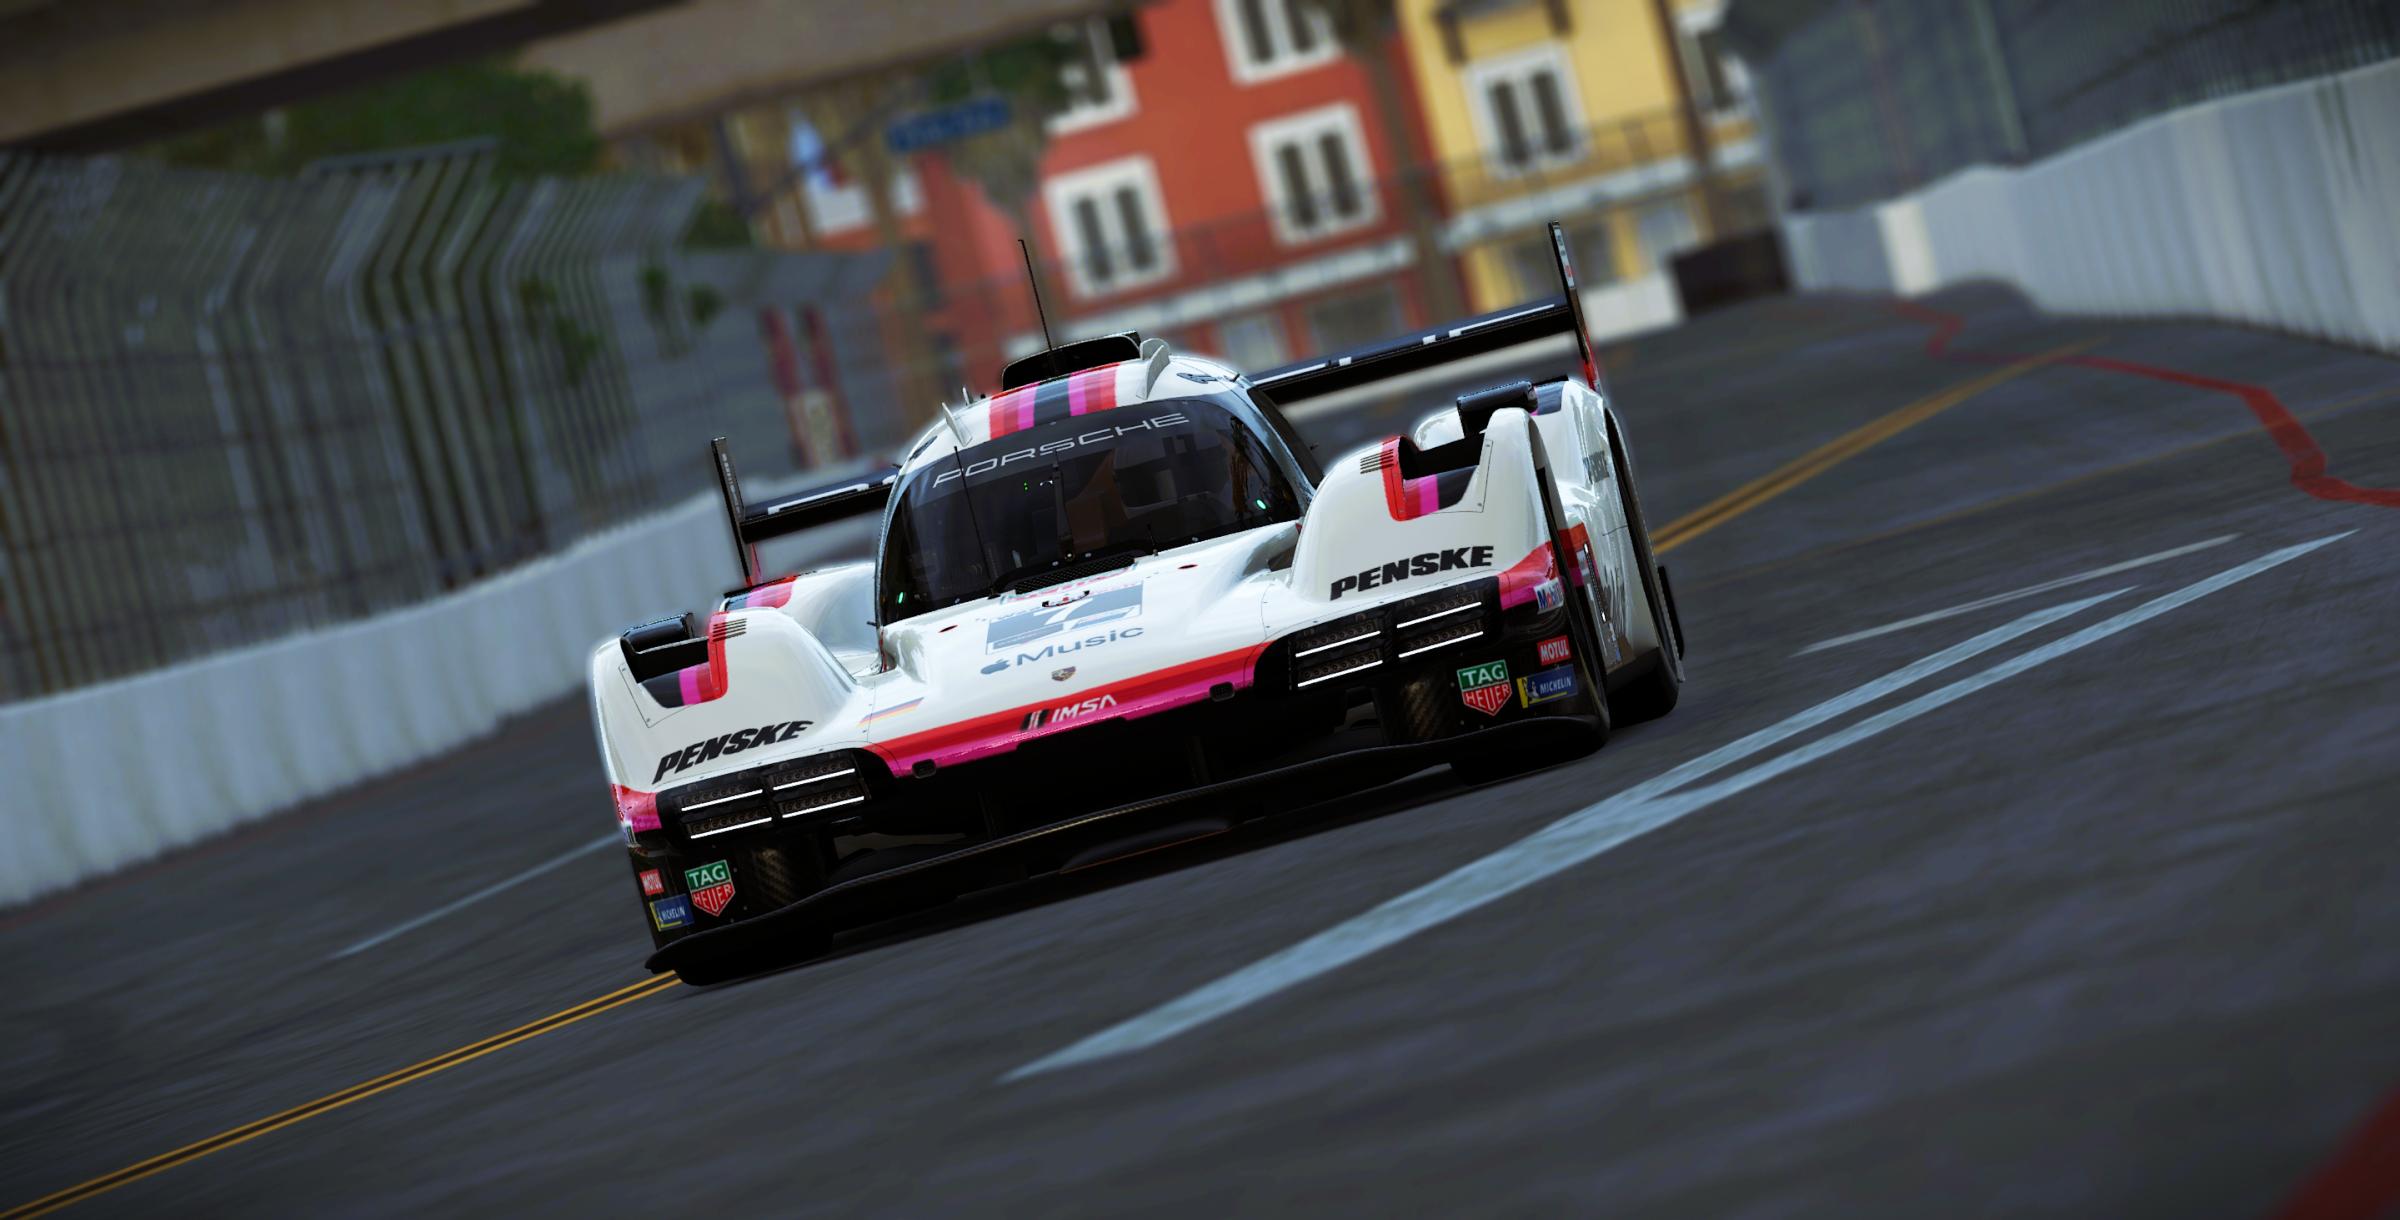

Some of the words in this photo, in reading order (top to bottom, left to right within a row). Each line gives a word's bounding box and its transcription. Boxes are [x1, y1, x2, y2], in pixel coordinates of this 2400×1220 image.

[933, 413, 1189, 488] PORSCHE
[1330, 546, 1494, 601] PENSKE
[1016, 627, 1144, 665] Music
[1540, 639, 1569, 661] MOTUL
[1462, 664, 1504, 686] TAG
[1540, 676, 1572, 694] MICHELIN
[1051, 694, 1117, 723] IMSA
[1465, 684, 1510, 711] HEUER
[652, 720, 814, 785] PENSKE
[688, 865, 726, 888] TAG
[693, 883, 732, 912] HEUER
